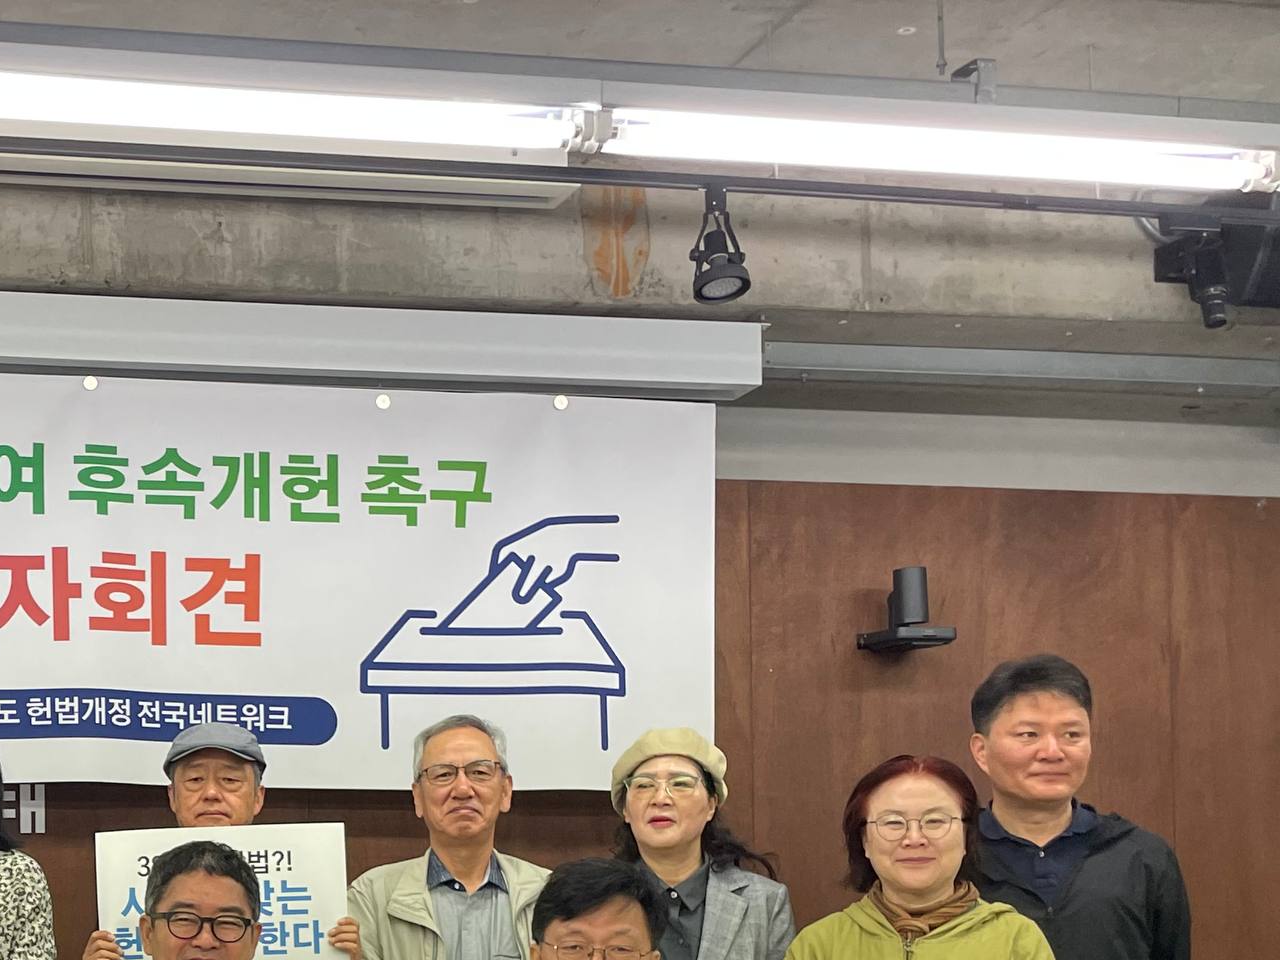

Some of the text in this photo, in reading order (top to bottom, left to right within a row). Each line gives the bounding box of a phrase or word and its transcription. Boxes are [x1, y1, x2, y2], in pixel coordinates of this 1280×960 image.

[69, 444, 341, 524] 후속개헌
[360, 455, 492, 528] 촉구
[26, 696, 131, 727] 헌법개정
[137, 700, 293, 732] 전국네트워크
[258, 920, 325, 955] 한다
